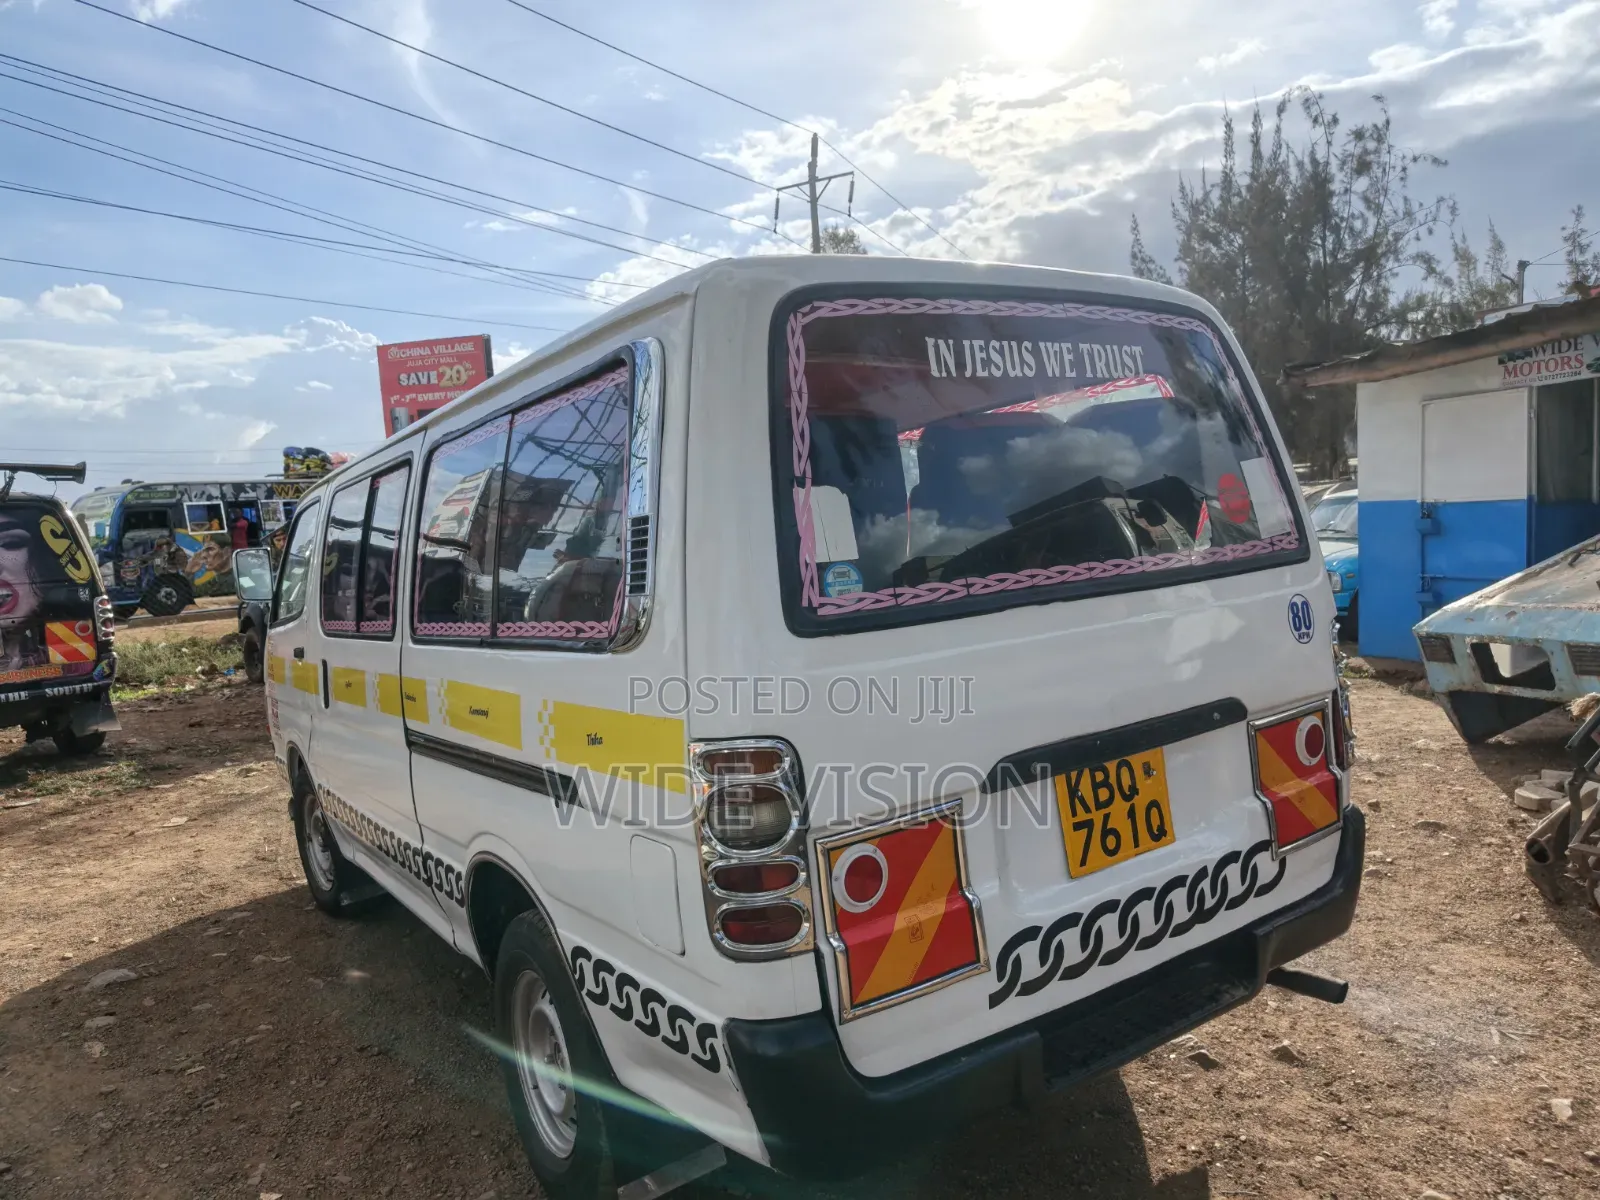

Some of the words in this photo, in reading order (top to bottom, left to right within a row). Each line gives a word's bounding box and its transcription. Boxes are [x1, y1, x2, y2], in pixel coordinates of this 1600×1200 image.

[400, 347, 431, 358] CHINA
[432, 342, 474, 353] VILLAGE
[925, 336, 957, 378] IN
[962, 339, 1036, 378] JESUS
[1038, 341, 1076, 378] WE
[1078, 343, 1144, 379] TRUST
[1531, 337, 1584, 358] WIDE
[424, 358, 438, 366] CITY
[439, 356, 458, 364] MALL
[1502, 353, 1584, 379] MOTORS
[399, 370, 438, 386] SAVE
[417, 391, 445, 402] EVERY
[1290, 600, 1312, 632] 80
[45, 683, 93, 698] SOUTH
[1065, 758, 1139, 818] KBQ
[1072, 799, 1167, 867] 761Q
